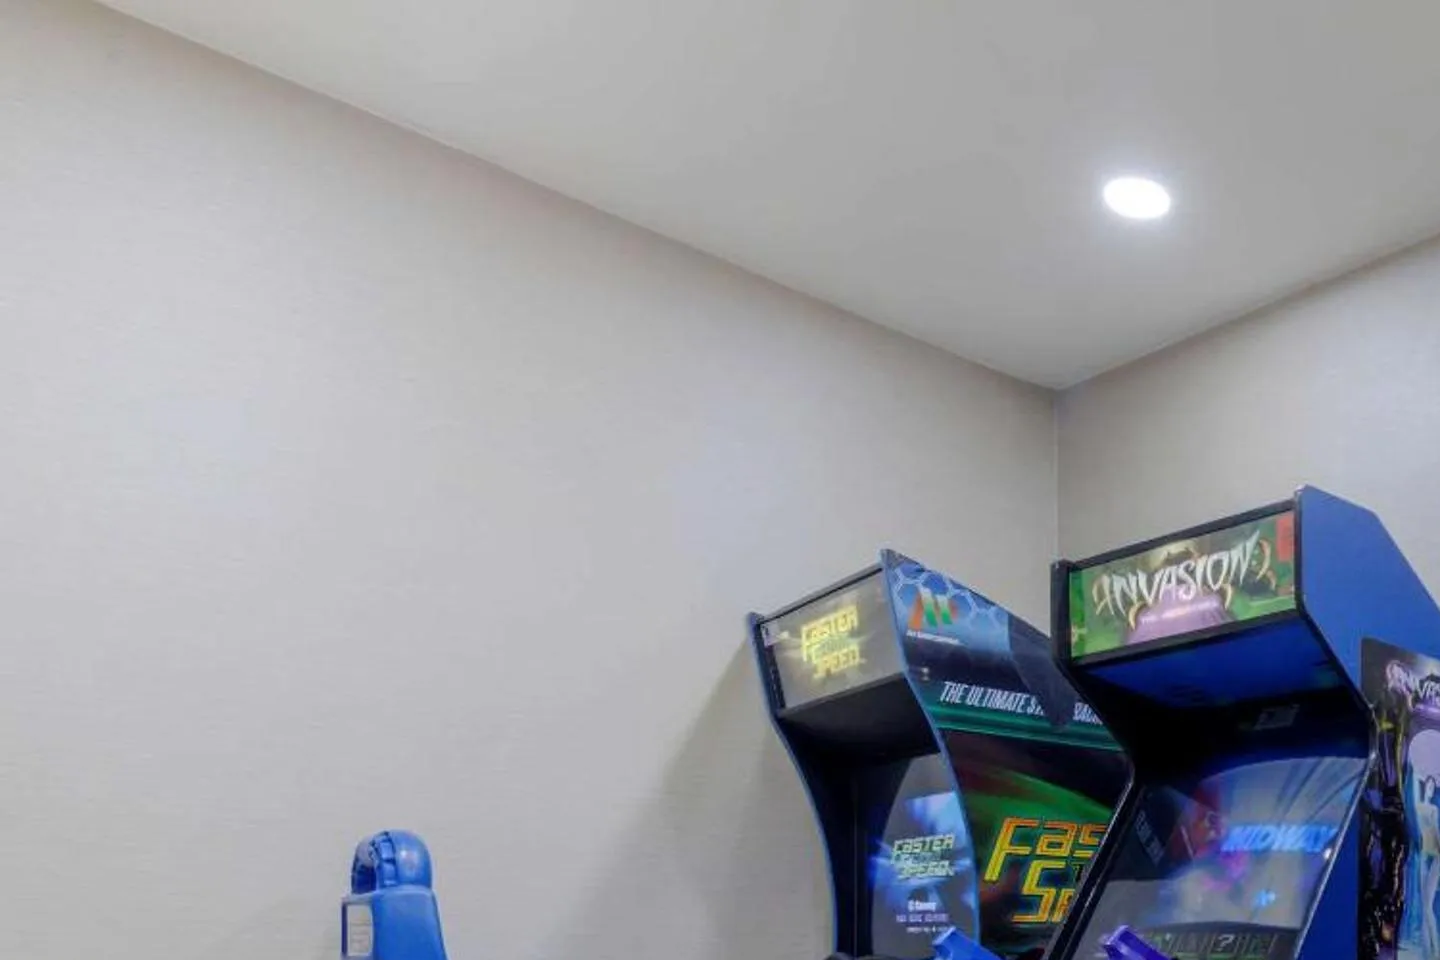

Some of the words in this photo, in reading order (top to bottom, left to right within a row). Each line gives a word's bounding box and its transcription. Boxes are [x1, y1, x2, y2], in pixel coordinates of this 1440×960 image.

[1091, 529, 1262, 617] INVASION
[939, 681, 969, 704] THE
[967, 685, 1030, 714] ULTIMATE
